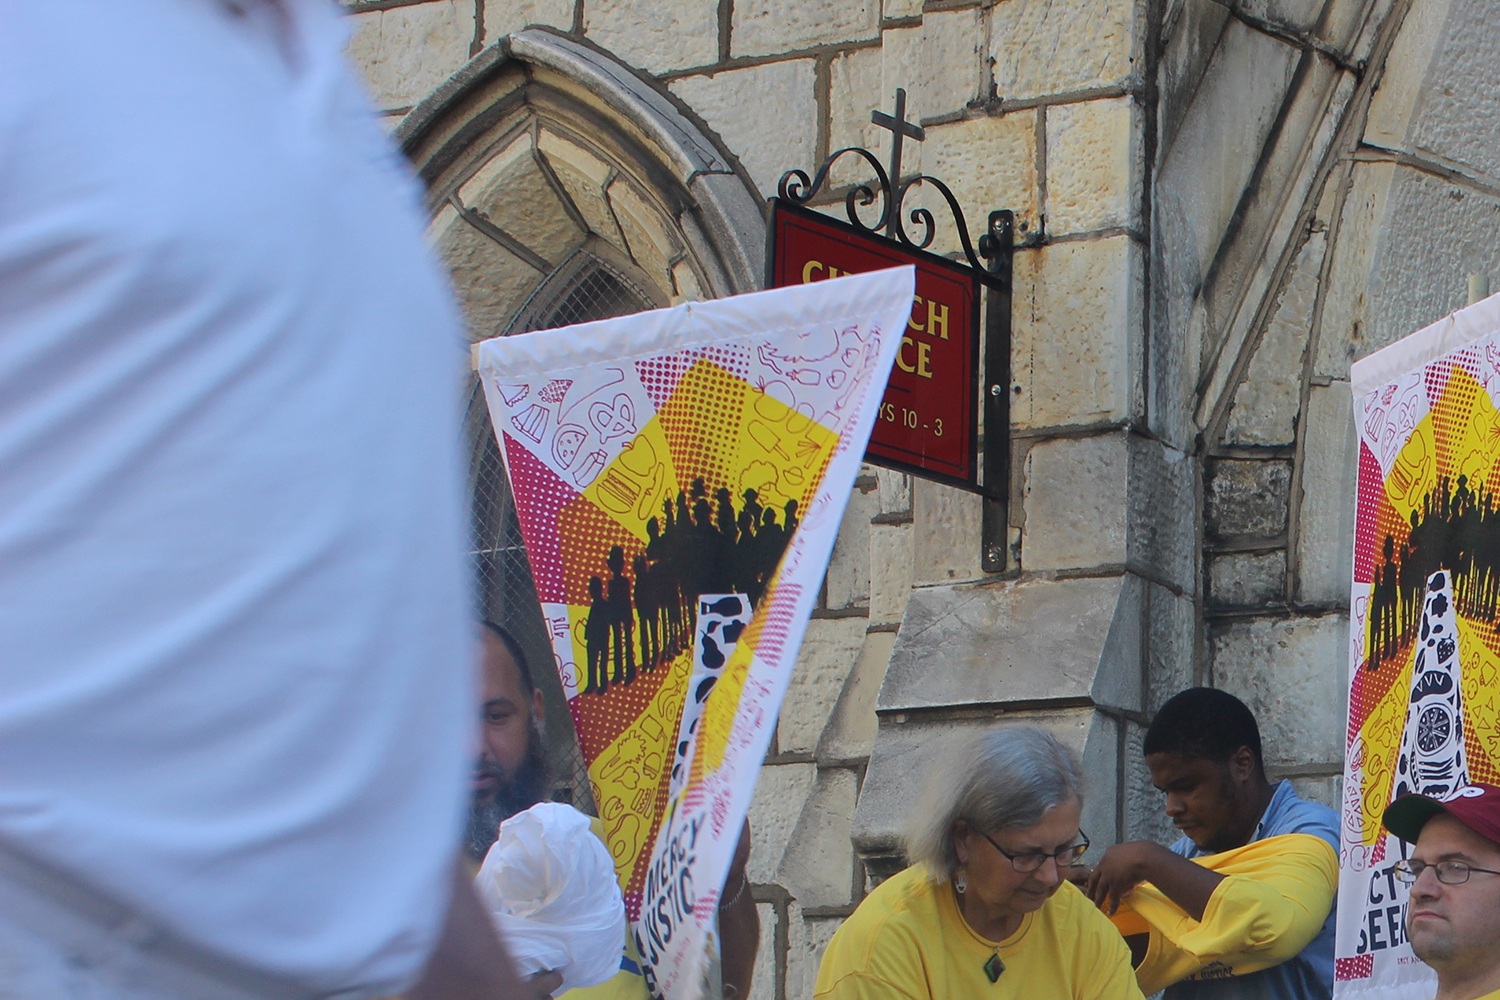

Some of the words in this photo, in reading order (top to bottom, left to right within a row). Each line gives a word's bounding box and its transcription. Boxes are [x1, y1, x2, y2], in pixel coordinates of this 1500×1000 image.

[895, 336, 934, 379] CE
[878, 402, 895, 422] YS
[902, 407, 918, 429] 10
[934, 418, 944, 437] 3
[647, 811, 706, 906] MERCY
[1366, 867, 1397, 907] CT
[645, 857, 696, 966] JUSTIC
